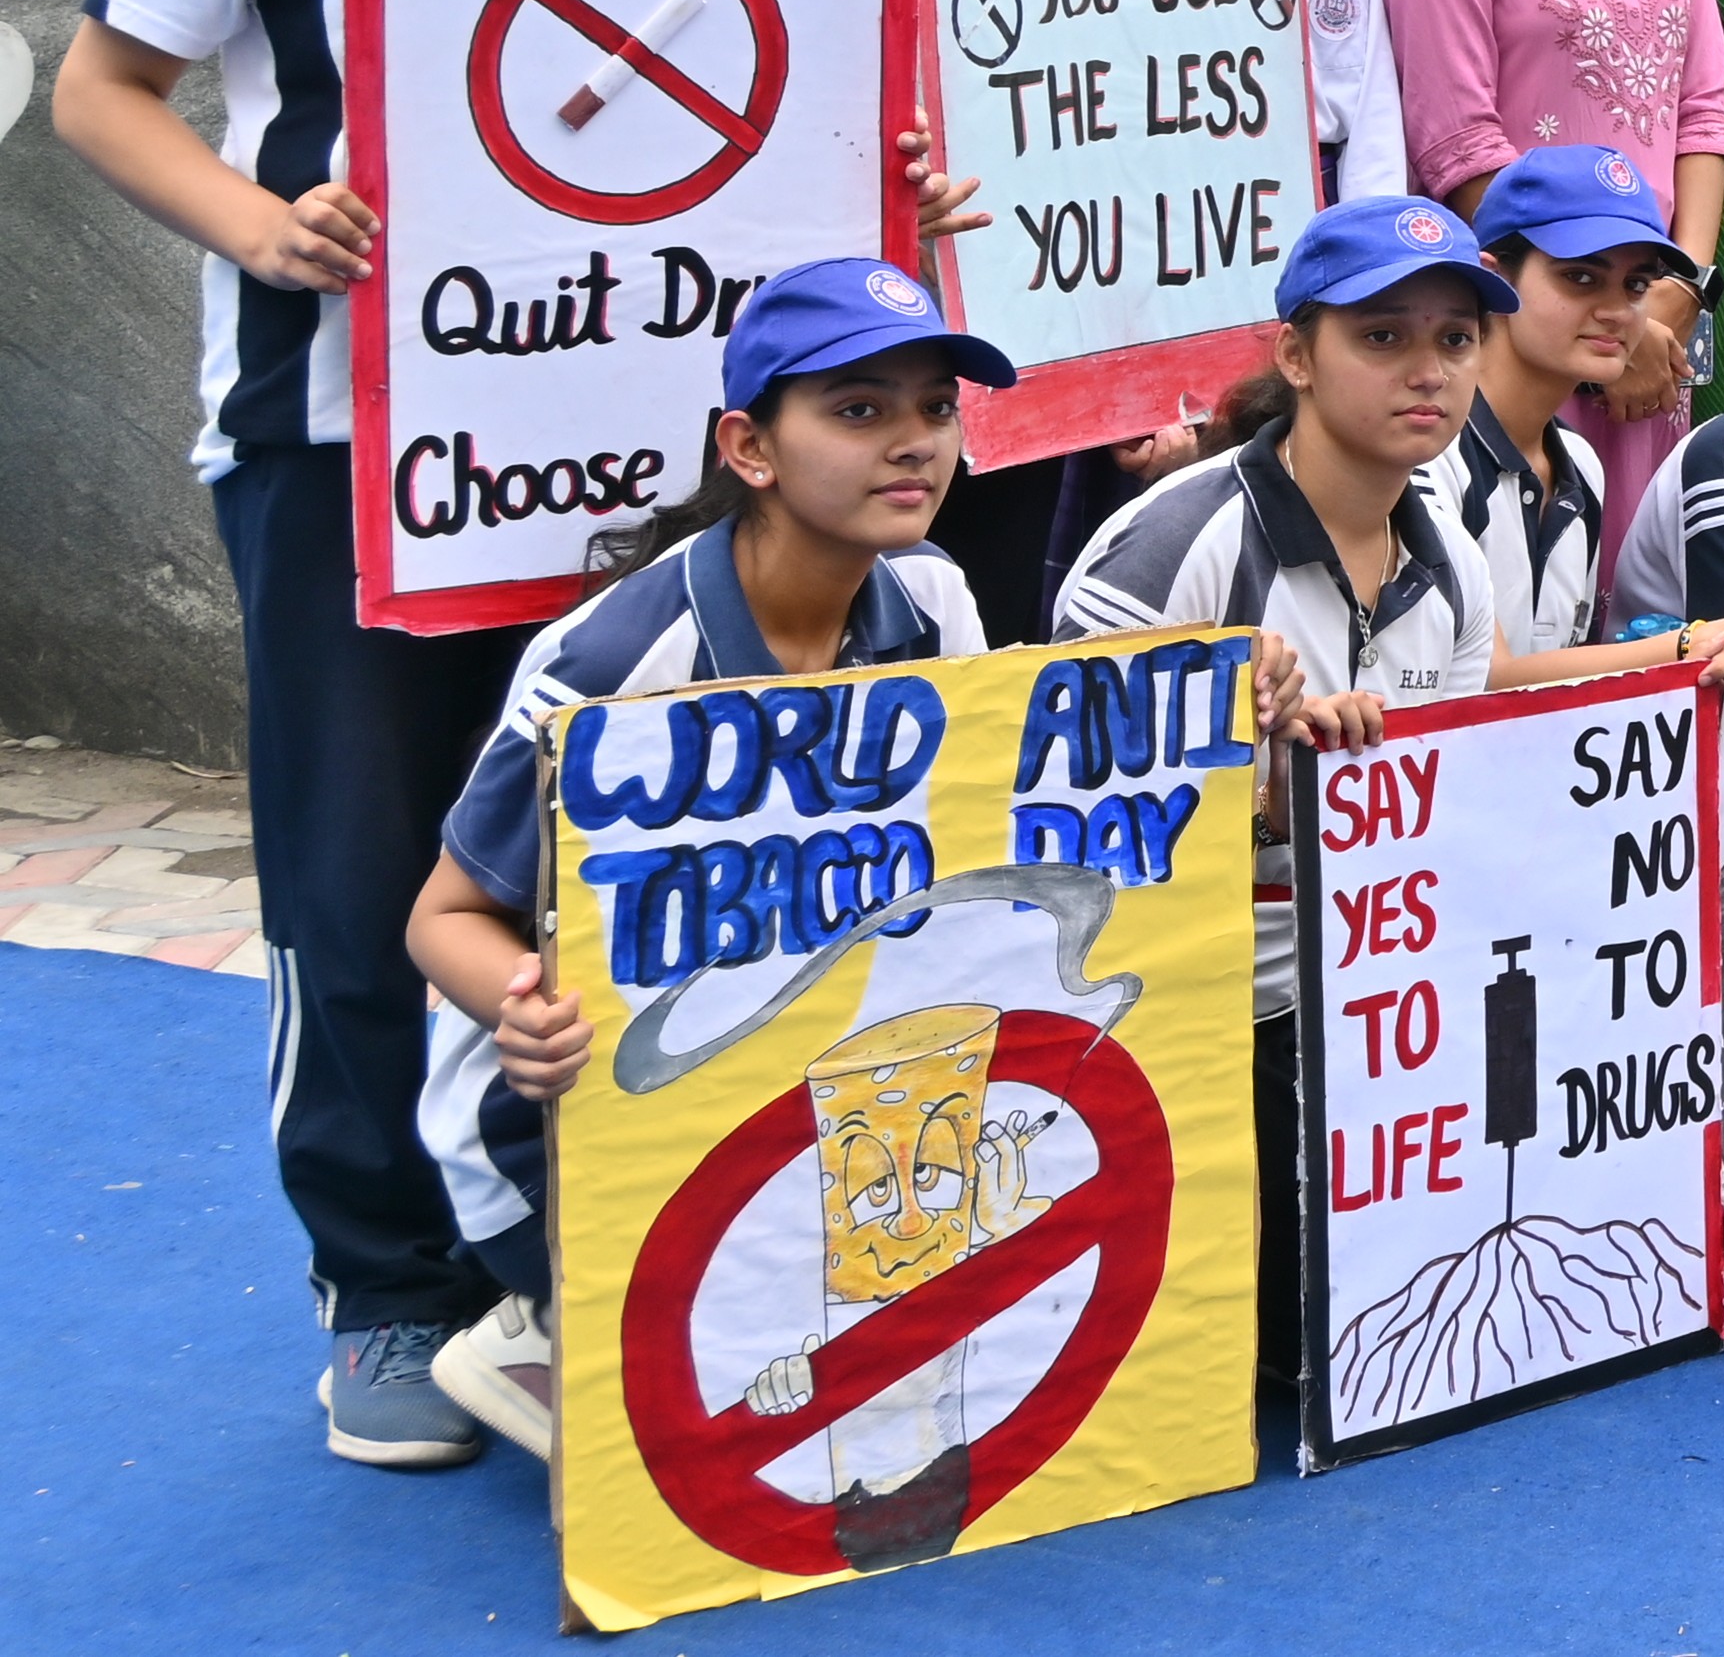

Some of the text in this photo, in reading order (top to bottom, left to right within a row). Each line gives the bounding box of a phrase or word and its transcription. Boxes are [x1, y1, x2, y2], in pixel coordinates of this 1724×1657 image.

[988, 45, 1268, 157] THE LESS
[1014, 197, 1123, 292] YOU
[1155, 179, 1281, 286] LIVE
[420, 250, 621, 357] Quit
[393, 430, 665, 539] Choose
[558, 635, 1254, 831] WORLD ANTI
[1569, 707, 1694, 808] SAY
[1320, 748, 1442, 853] SAY
[580, 781, 1201, 989] TOBACCO DAY
[1611, 812, 1695, 909] NO
[1332, 870, 1438, 969] YES
[1343, 980, 1442, 1080] TO
[1595, 937, 1687, 1021] TO
[1556, 1033, 1716, 1160] DRUGS
[1331, 1102, 1469, 1214] LIFE
